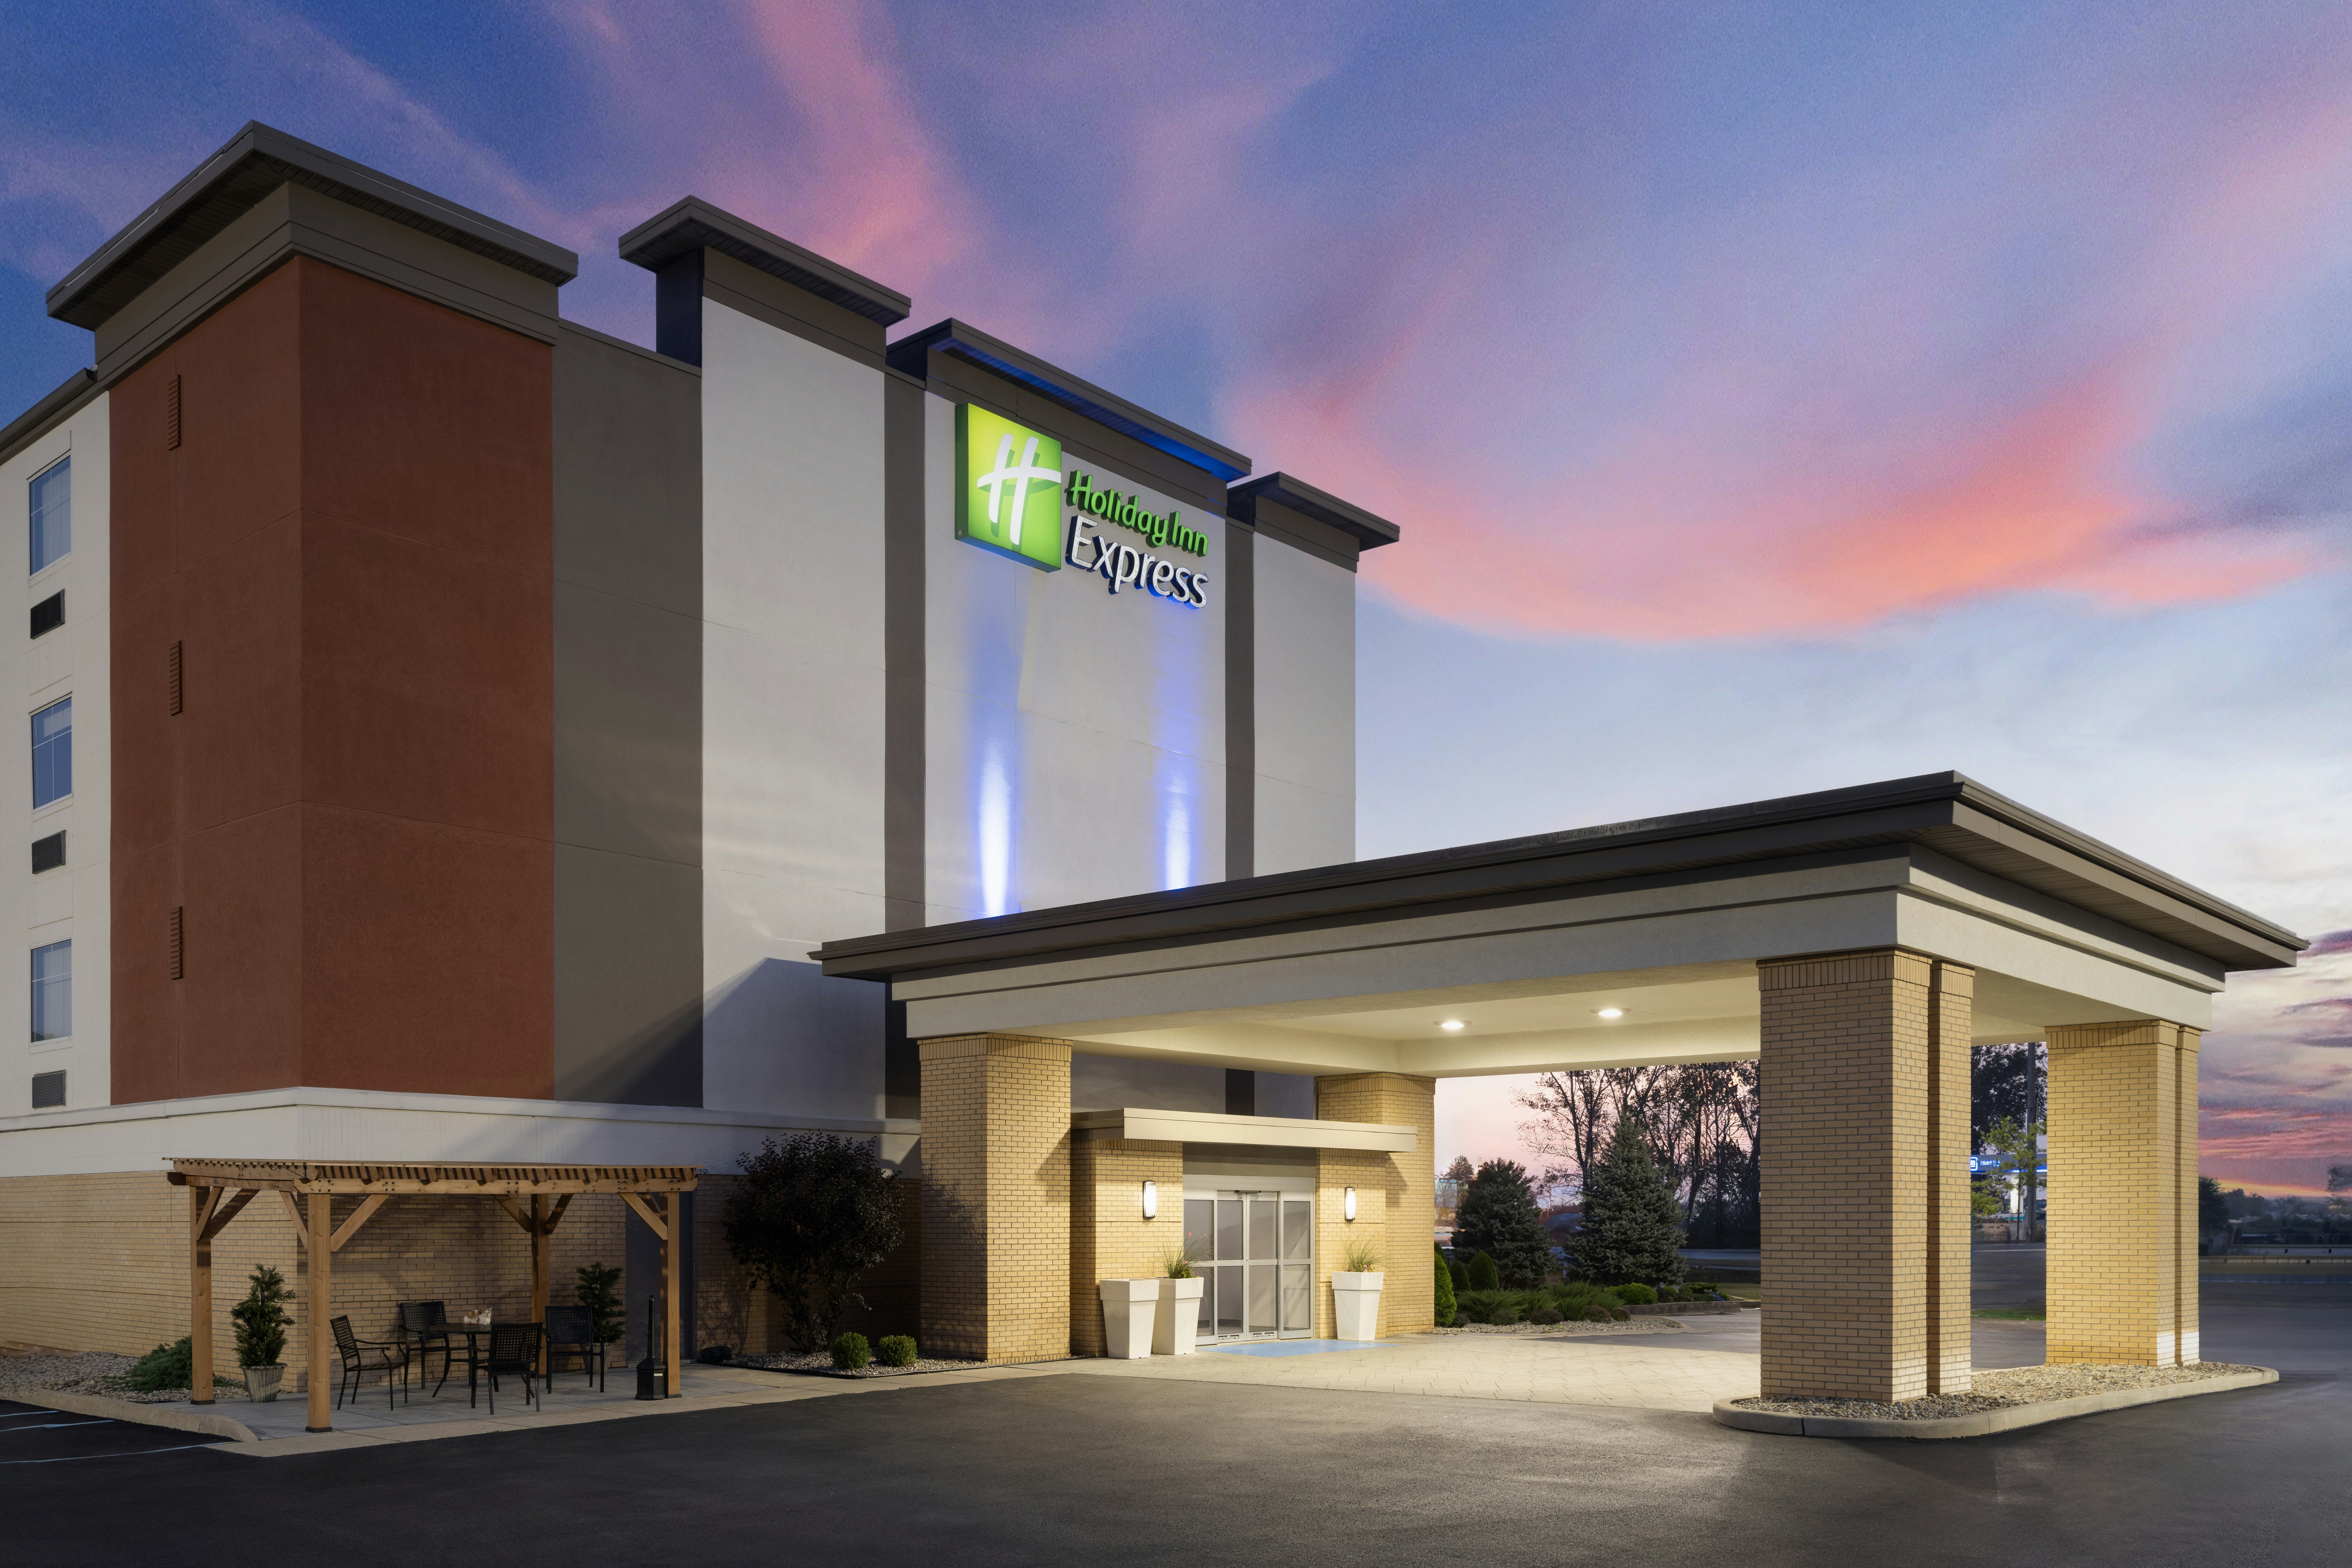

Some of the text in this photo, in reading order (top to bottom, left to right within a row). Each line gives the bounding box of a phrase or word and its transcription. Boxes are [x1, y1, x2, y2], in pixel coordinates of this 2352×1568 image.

[1065, 470, 1208, 556] Holiday Inn
[1067, 515, 1209, 608] Express
